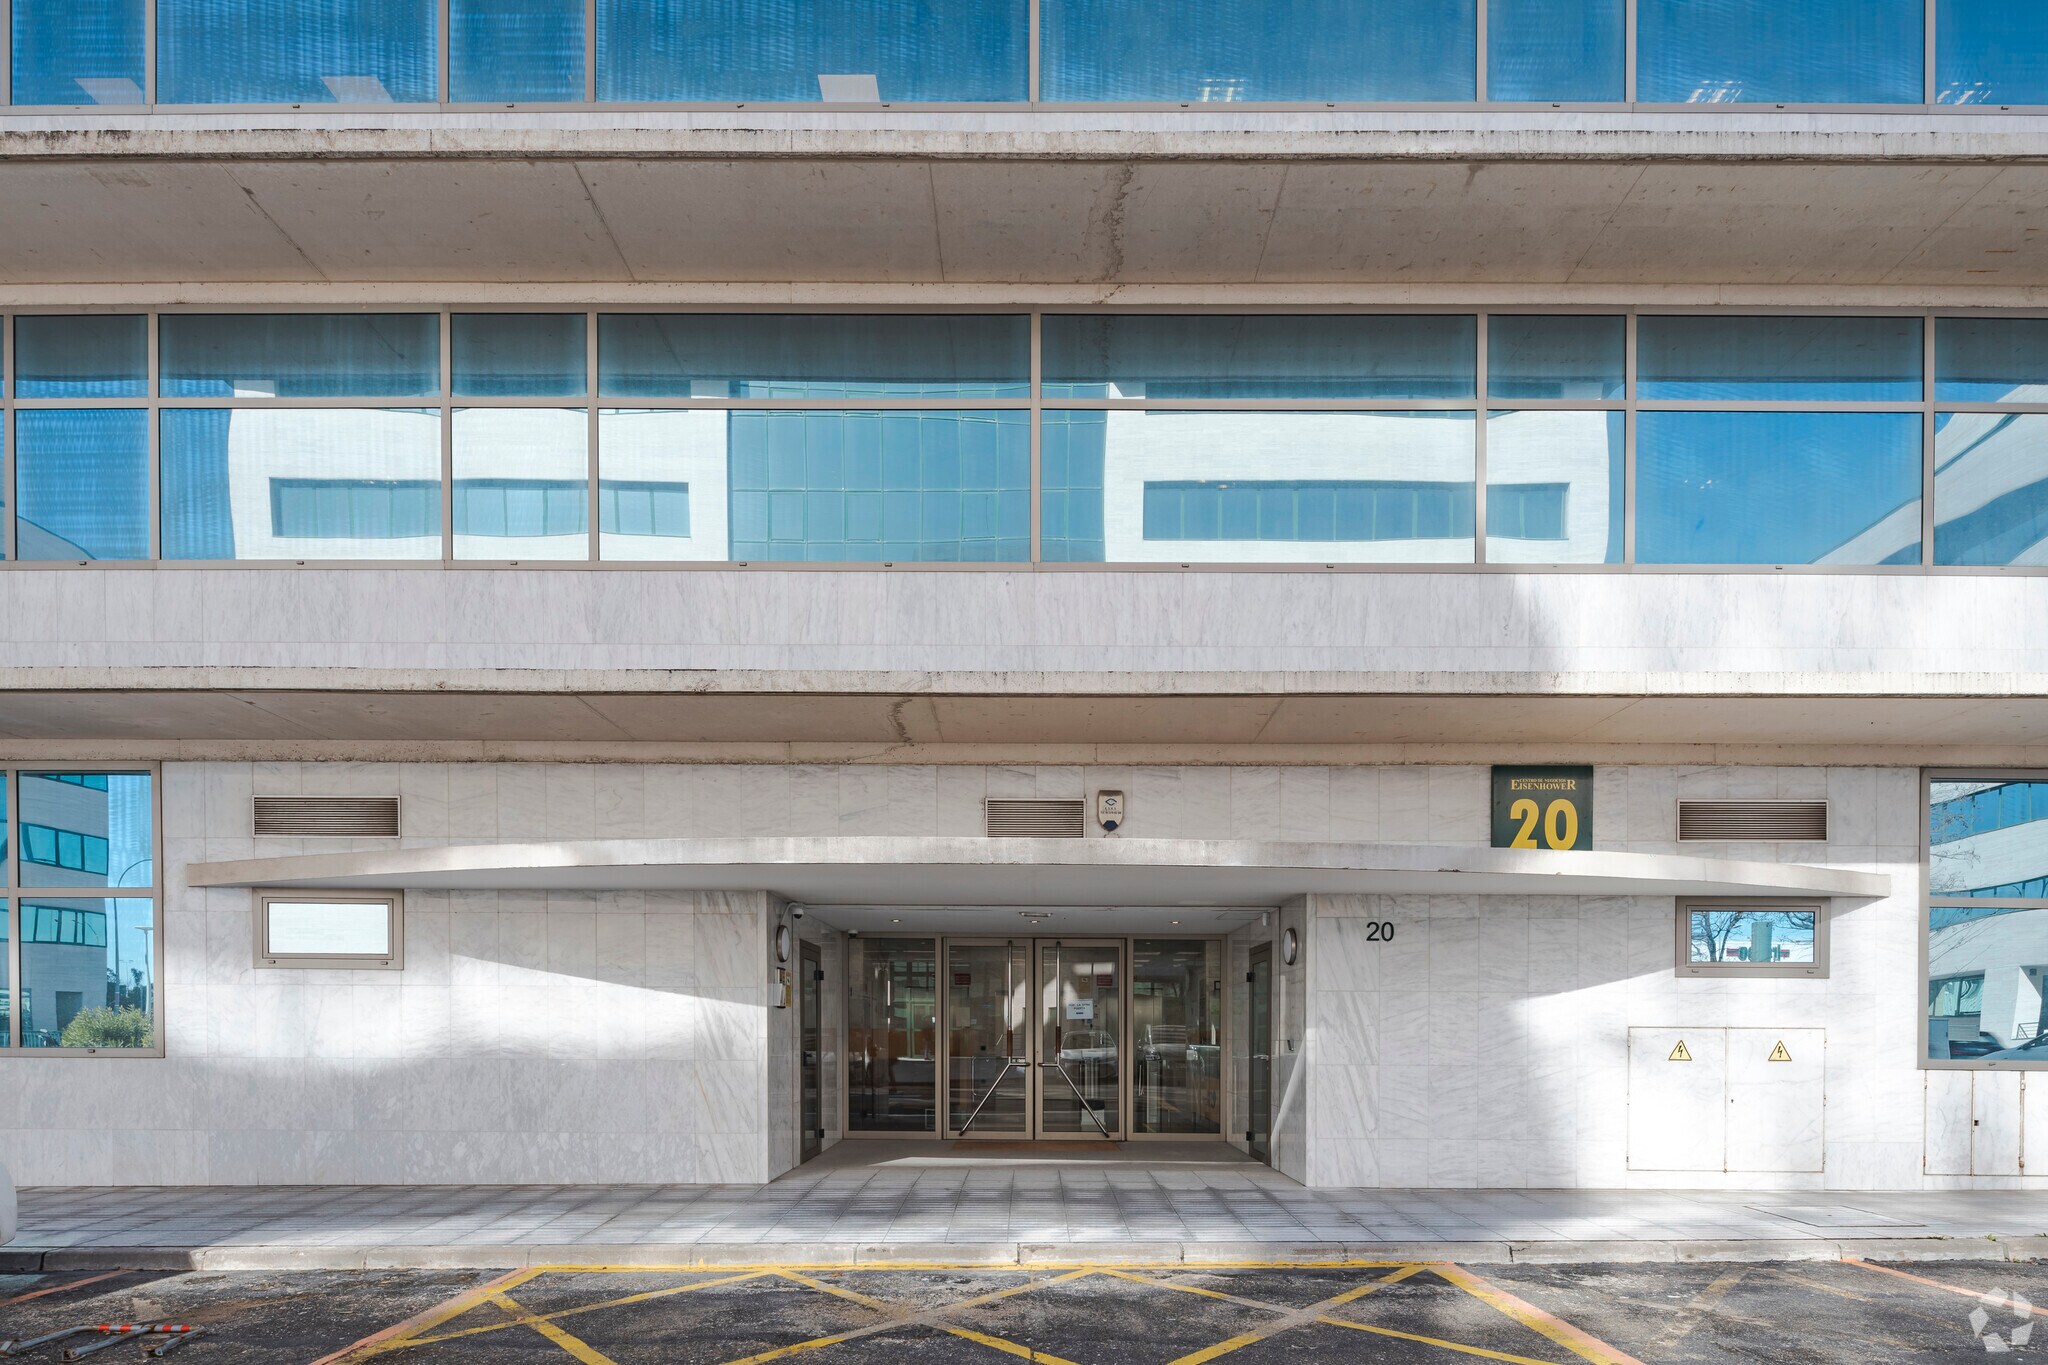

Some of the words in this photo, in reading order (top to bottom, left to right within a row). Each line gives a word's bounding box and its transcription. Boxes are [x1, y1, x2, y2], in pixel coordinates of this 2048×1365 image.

[1511, 779, 1576, 790] EISENHOWER
[1510, 798, 1578, 850] 20
[1366, 921, 1394, 941] 20
